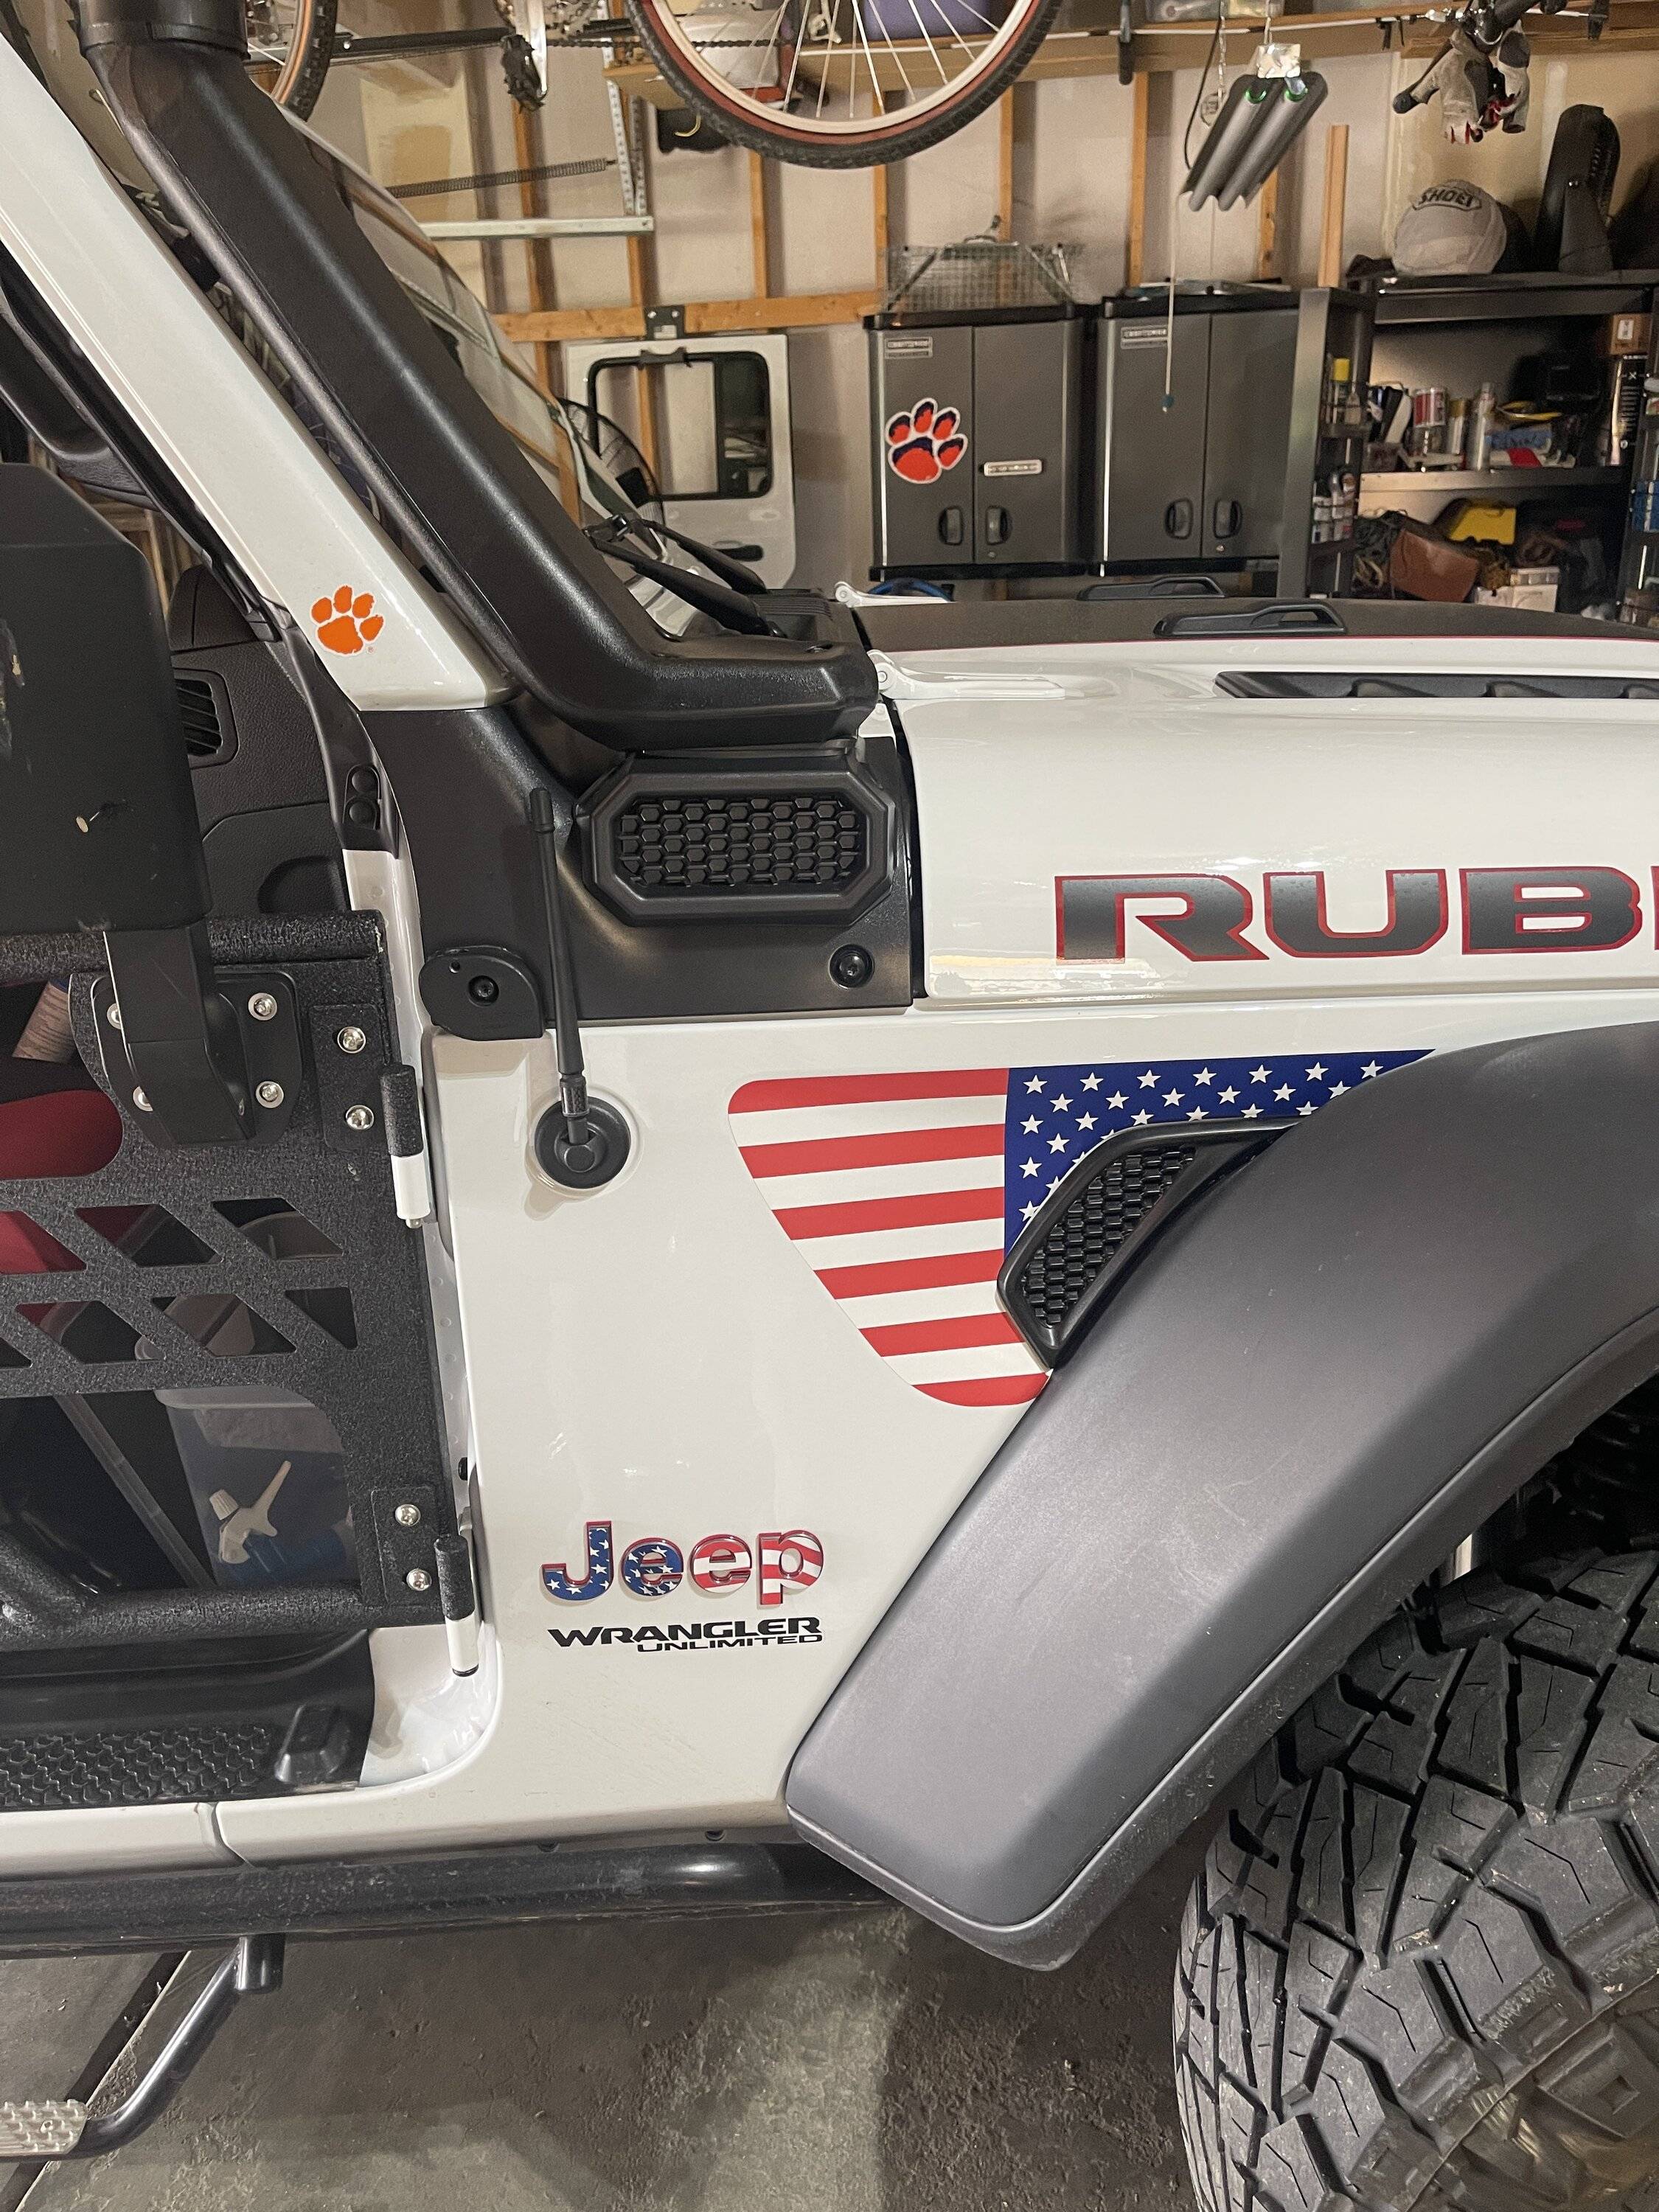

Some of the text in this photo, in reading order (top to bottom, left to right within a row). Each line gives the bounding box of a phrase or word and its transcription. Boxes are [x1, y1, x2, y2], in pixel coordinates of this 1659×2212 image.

[1417, 189, 1475, 207] SHOEI
[1055, 866, 1659, 964] RUB
[541, 1520, 824, 1605] Jeep
[547, 1616, 822, 1648] WRANGLER
[637, 1634, 823, 1653] UNLIMITED
